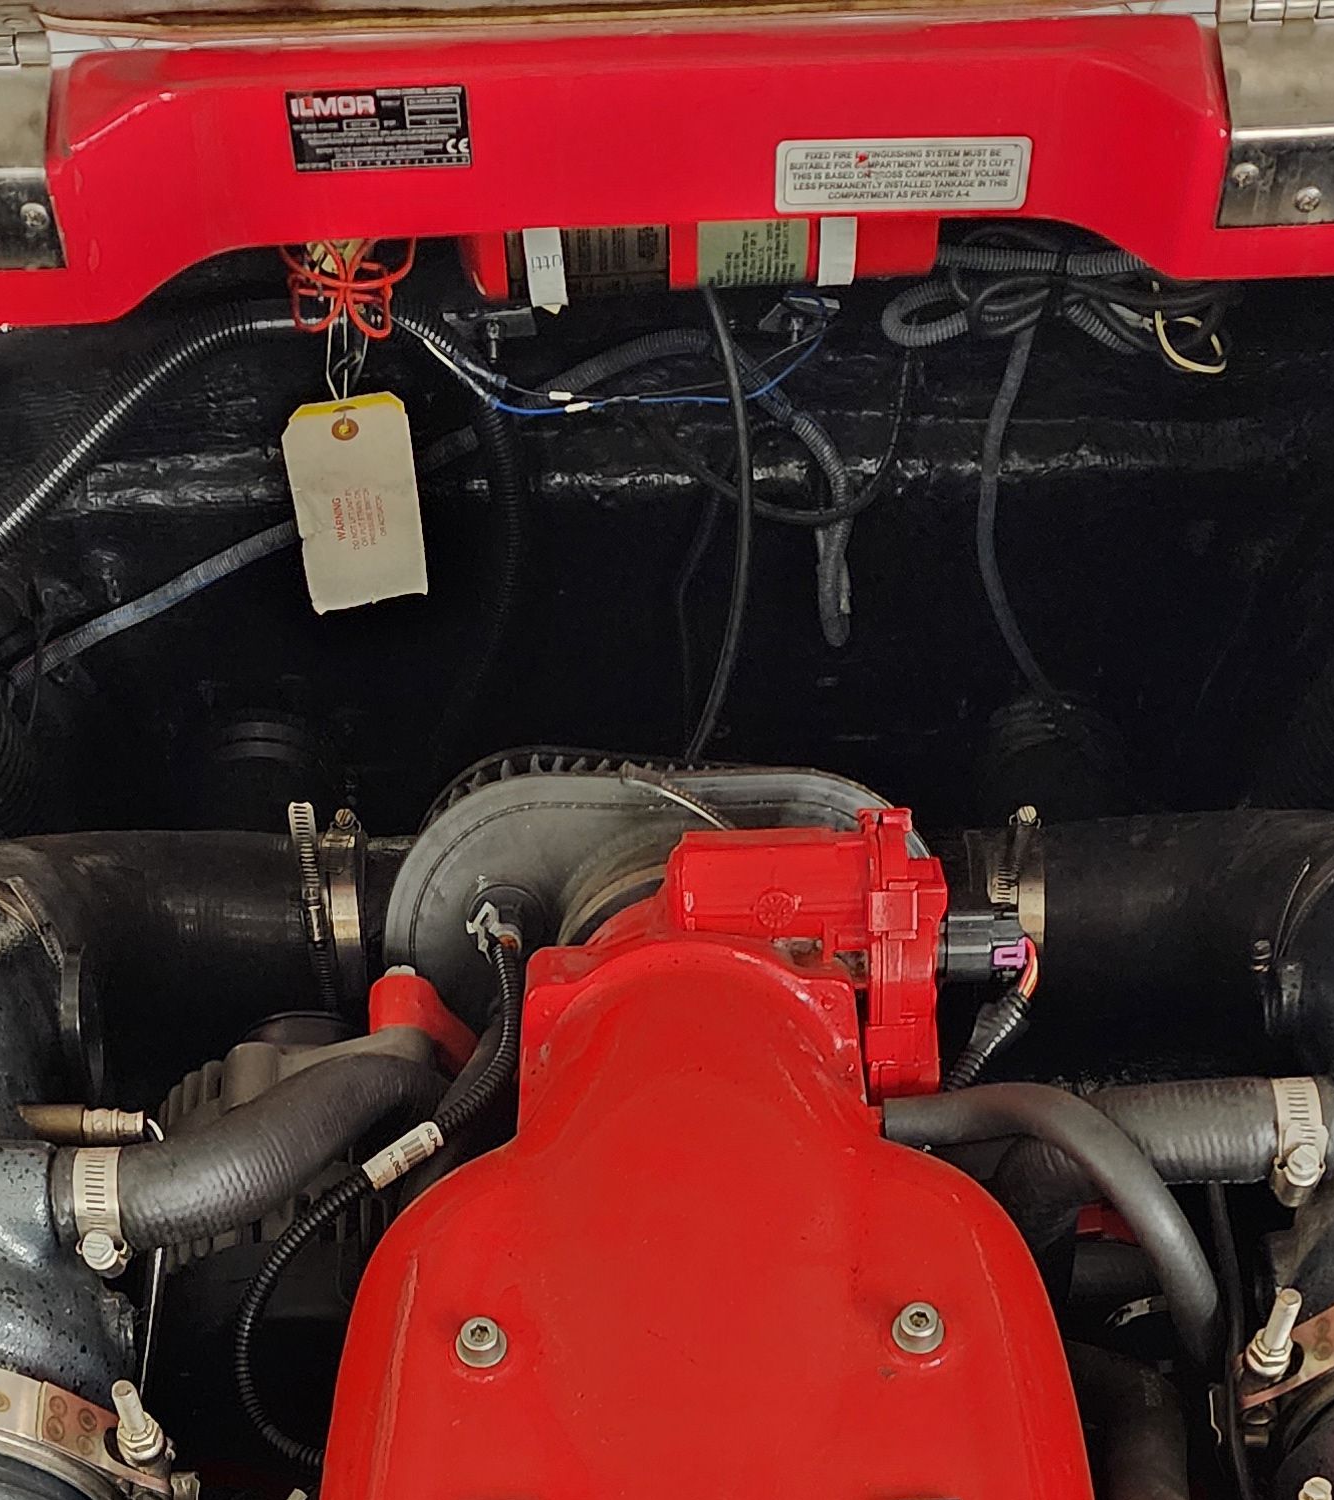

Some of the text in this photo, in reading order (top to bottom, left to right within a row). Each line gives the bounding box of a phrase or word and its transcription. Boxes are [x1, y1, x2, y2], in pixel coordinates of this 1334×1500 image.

[290, 95, 376, 117] ILMOR
[445, 137, 469, 153] CE
[805, 148, 1002, 160] FIXED FIRE ETINGUISHING SYSTEM MUST BE
[789, 162, 833, 170] SUITABLE
[834, 161, 852, 169] FOR
[924, 159, 961, 168] VOLUME
[963, 159, 973, 168] OF
[988, 159, 1001, 167] CU
[792, 172, 812, 180] THIS
[814, 172, 822, 180] IS
[825, 171, 855, 180] BASED
[905, 169, 971, 178] COMPARTMENT
[975, 168, 1011, 177] VOLUME
[793, 179, 1009, 190] LESS PERMANENTLY INSTALLED TANKAGE IN THIS
[828, 190, 896, 200] COMPARTMENT
[896, 190, 908, 199] AS
[911, 190, 928, 198] PER
[930, 190, 954, 198] ABYC
[331, 497, 346, 541] WARNING
